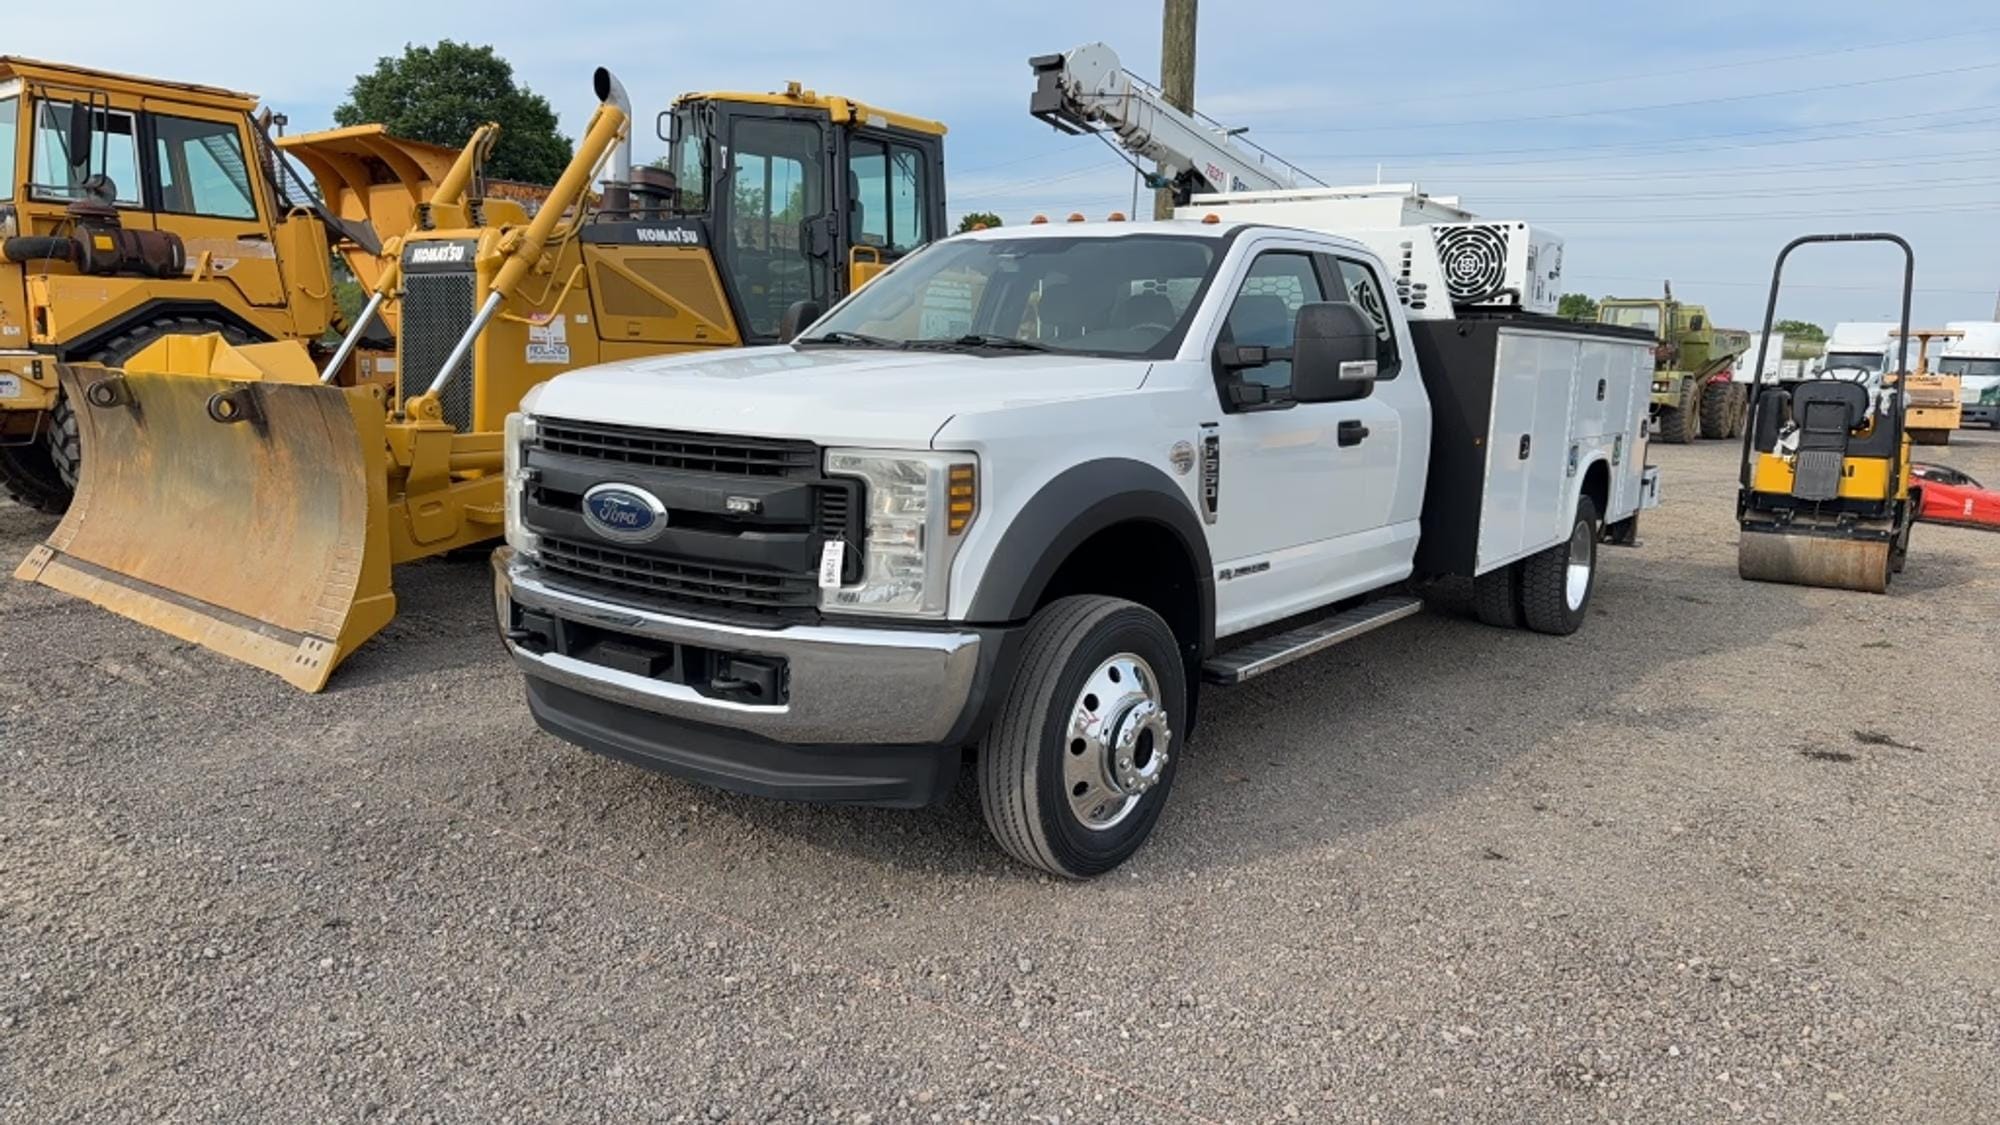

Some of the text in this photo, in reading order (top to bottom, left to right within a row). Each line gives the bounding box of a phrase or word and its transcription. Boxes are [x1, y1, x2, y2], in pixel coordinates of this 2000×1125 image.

[636, 226, 699, 244] KOMATSU
[412, 242, 465, 263] KOMATSU
[599, 497, 639, 526] Ford
